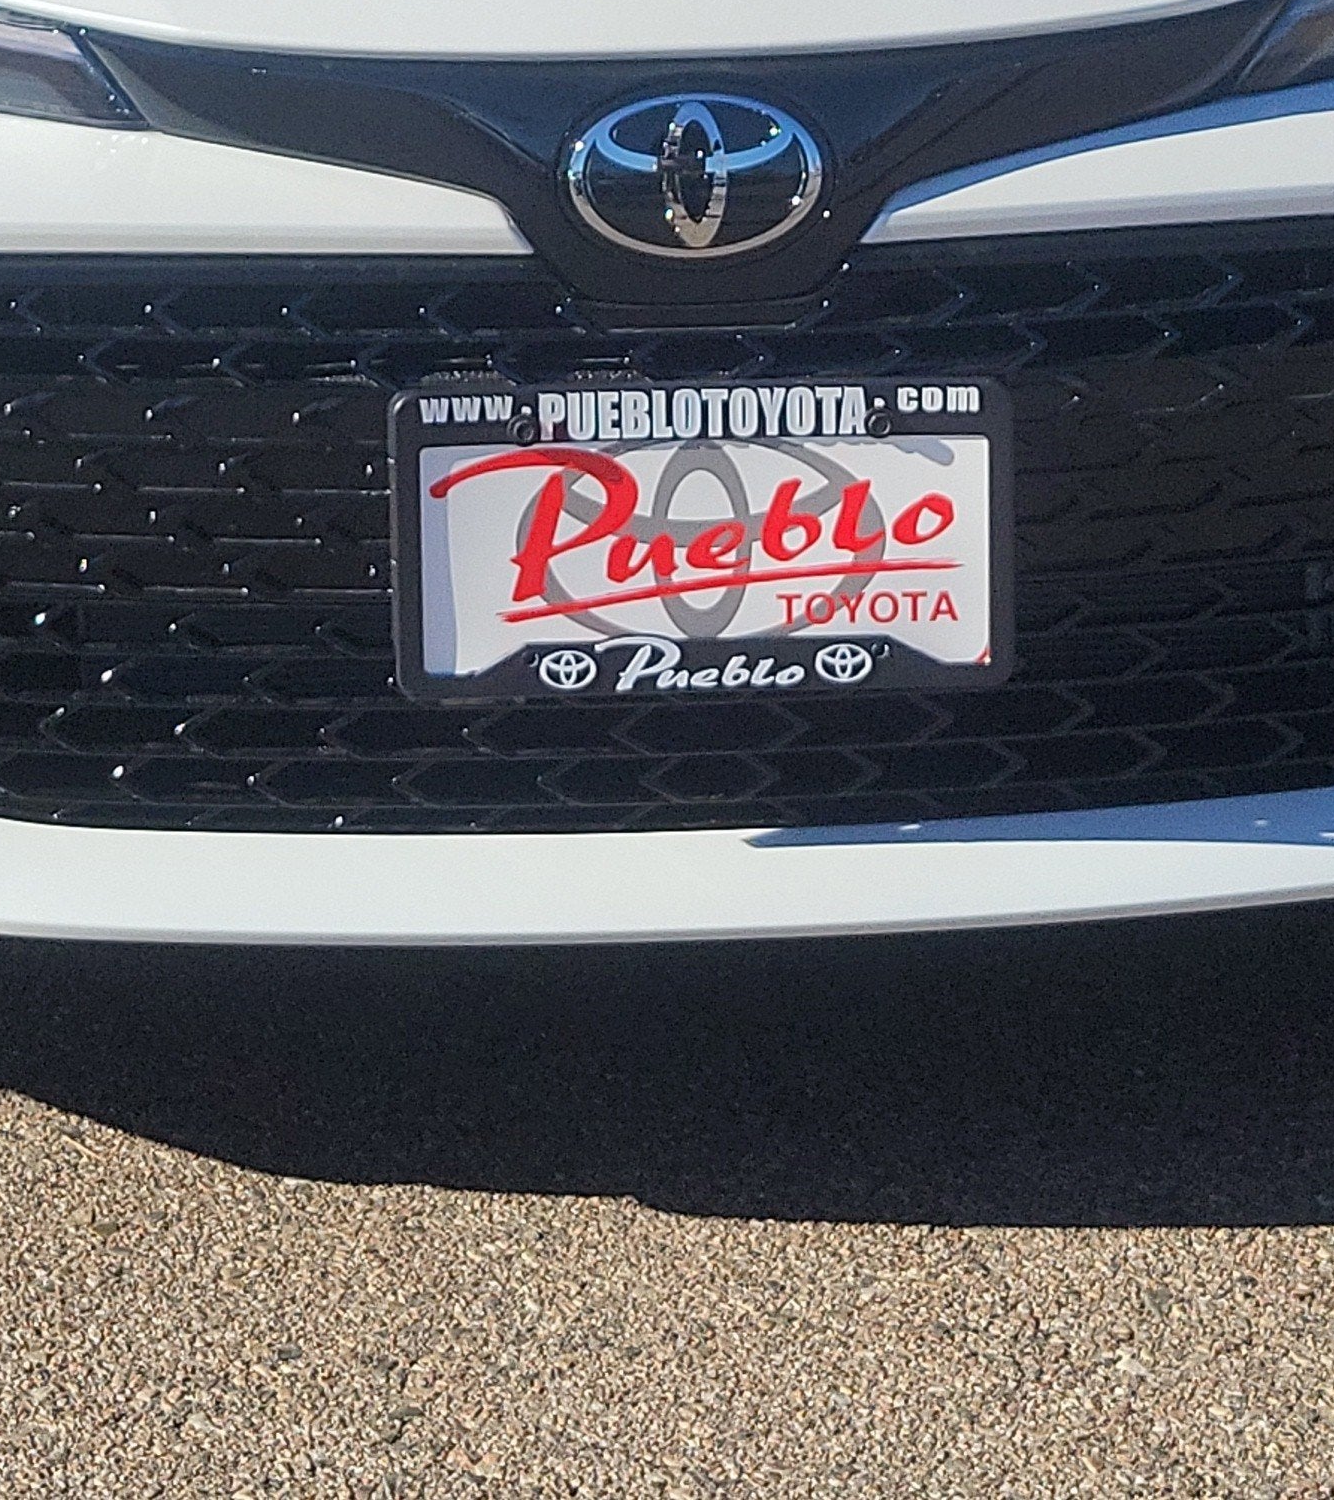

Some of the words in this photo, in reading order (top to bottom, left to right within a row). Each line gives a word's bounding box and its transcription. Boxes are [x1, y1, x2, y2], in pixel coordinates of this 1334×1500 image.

[430, 447, 954, 601] Pueblo
[776, 589, 958, 624] TOYOTA
[595, 636, 805, 691] Pueblo
